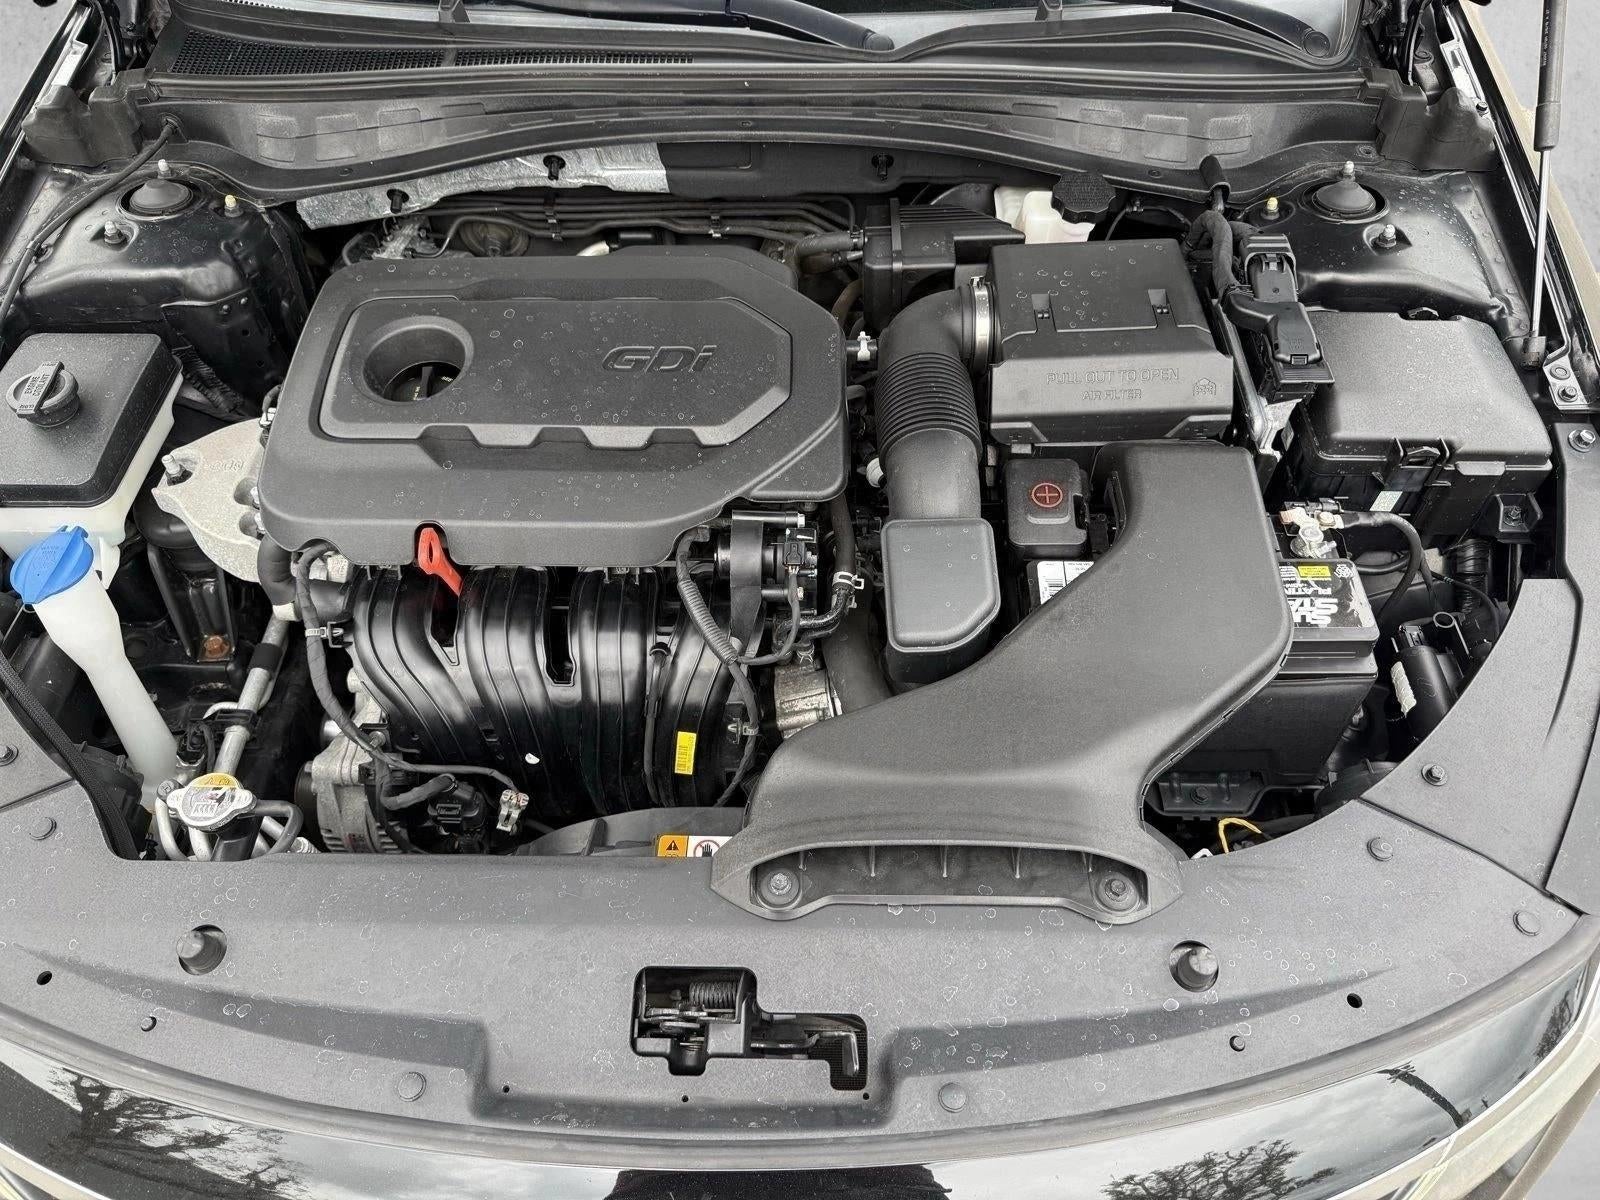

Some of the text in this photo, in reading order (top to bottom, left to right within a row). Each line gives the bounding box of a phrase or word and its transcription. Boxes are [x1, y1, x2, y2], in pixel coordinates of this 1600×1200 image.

[602, 345, 717, 372] GDi
[1046, 367, 1180, 385] PULL OUT TO OPEN
[1082, 388, 1142, 400] AIR FILTER
[1283, 587, 1332, 595] PLATIN
[1287, 598, 1338, 613] STA
